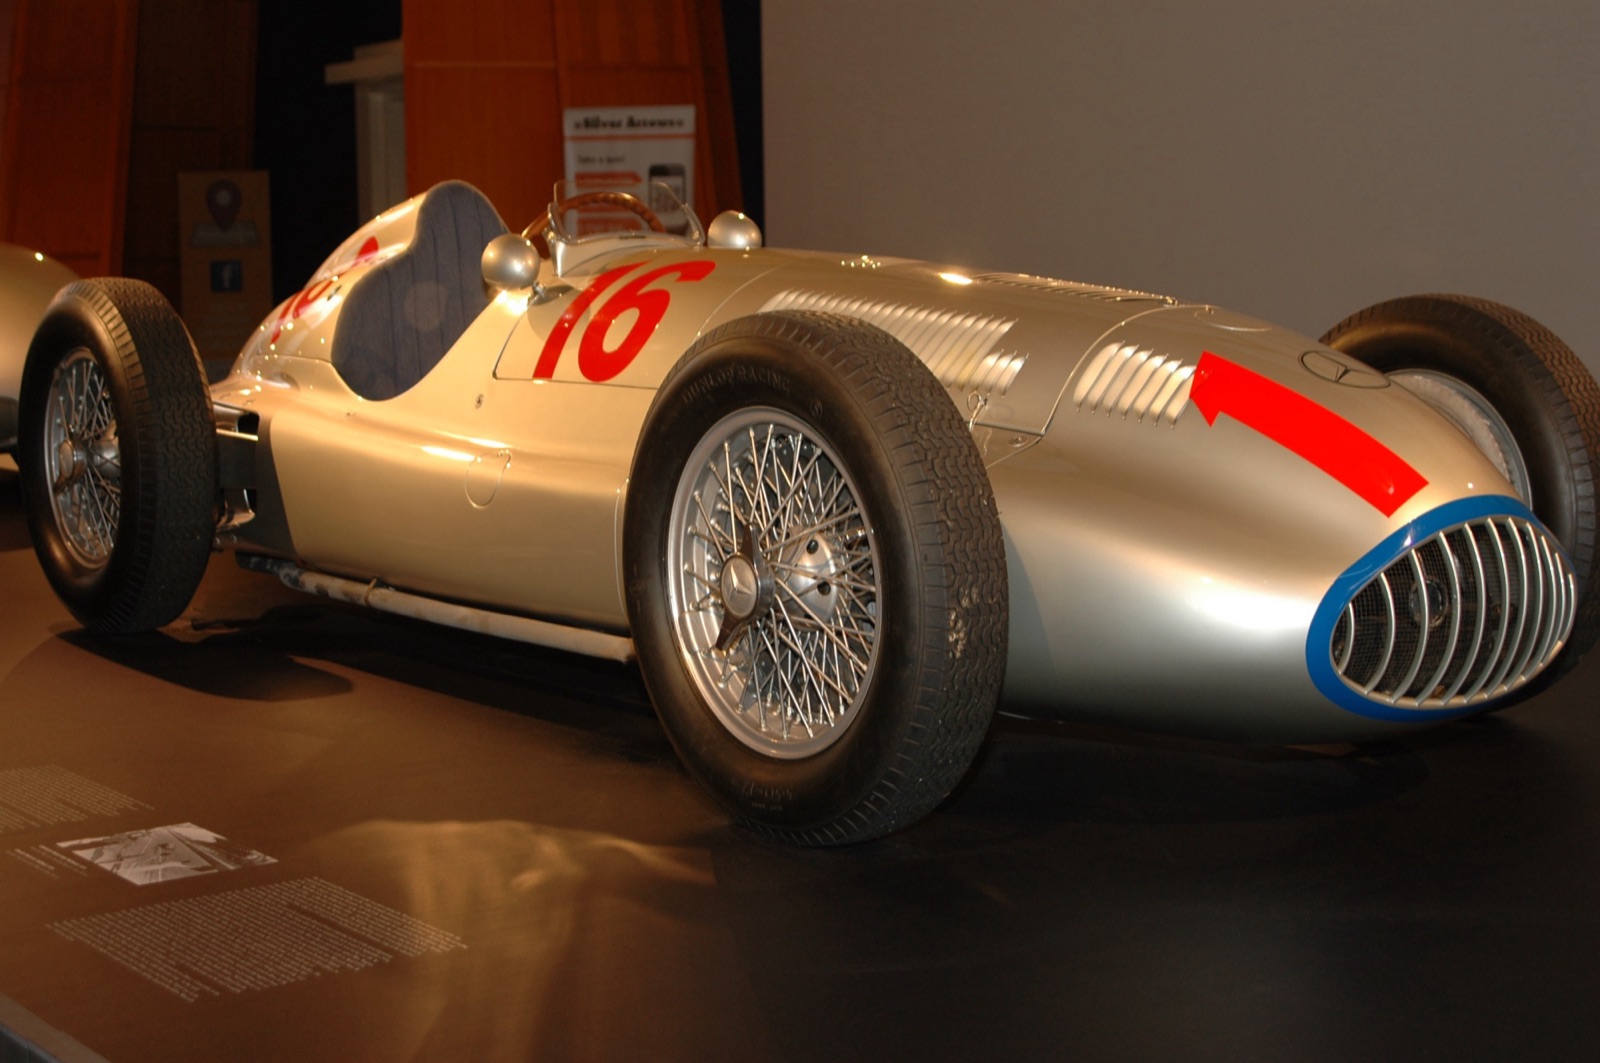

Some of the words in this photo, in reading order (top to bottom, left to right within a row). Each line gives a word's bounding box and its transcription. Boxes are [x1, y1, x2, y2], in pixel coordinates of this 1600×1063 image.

[532, 260, 716, 383] 16
[681, 366, 735, 404] DUNLOP
[737, 365, 790, 396] RACING
